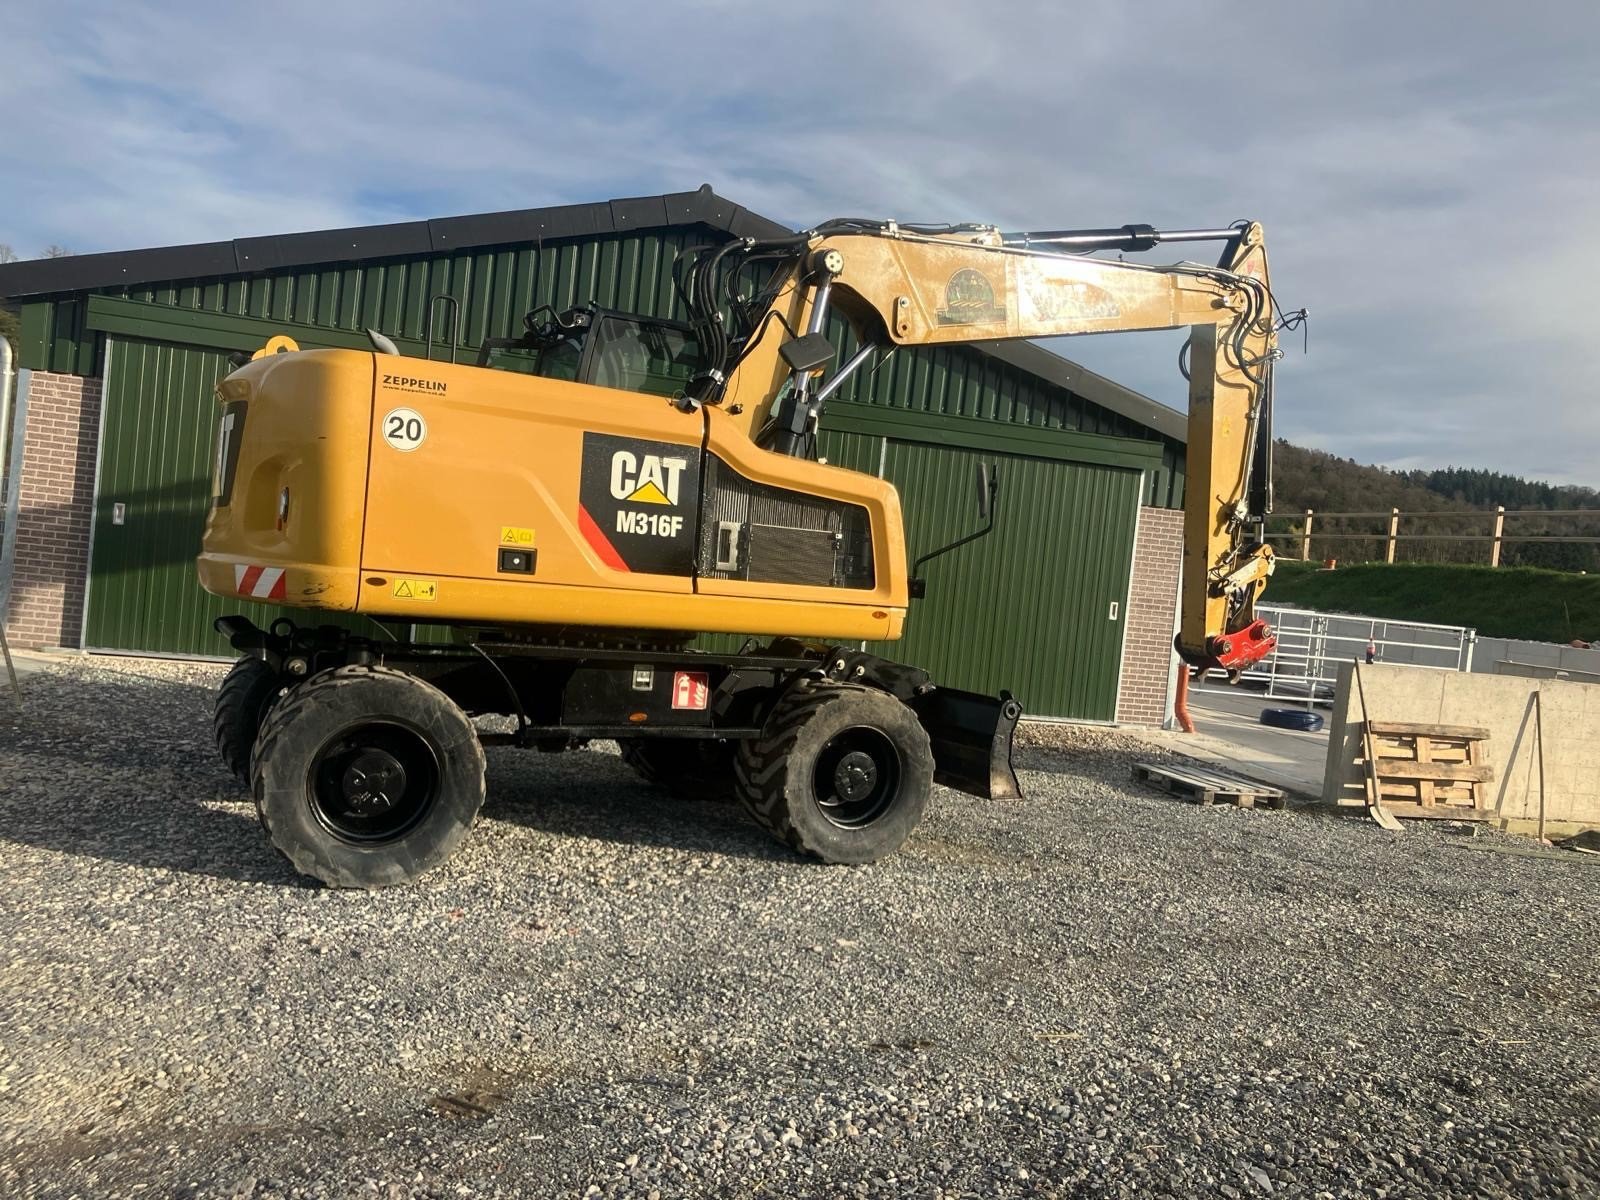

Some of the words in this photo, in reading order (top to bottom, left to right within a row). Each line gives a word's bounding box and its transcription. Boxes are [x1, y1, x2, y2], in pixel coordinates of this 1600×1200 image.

[383, 374, 447, 391] ZEPPELIN
[388, 416, 422, 442] 20
[610, 450, 687, 506] CAT
[616, 510, 683, 538] M316F
